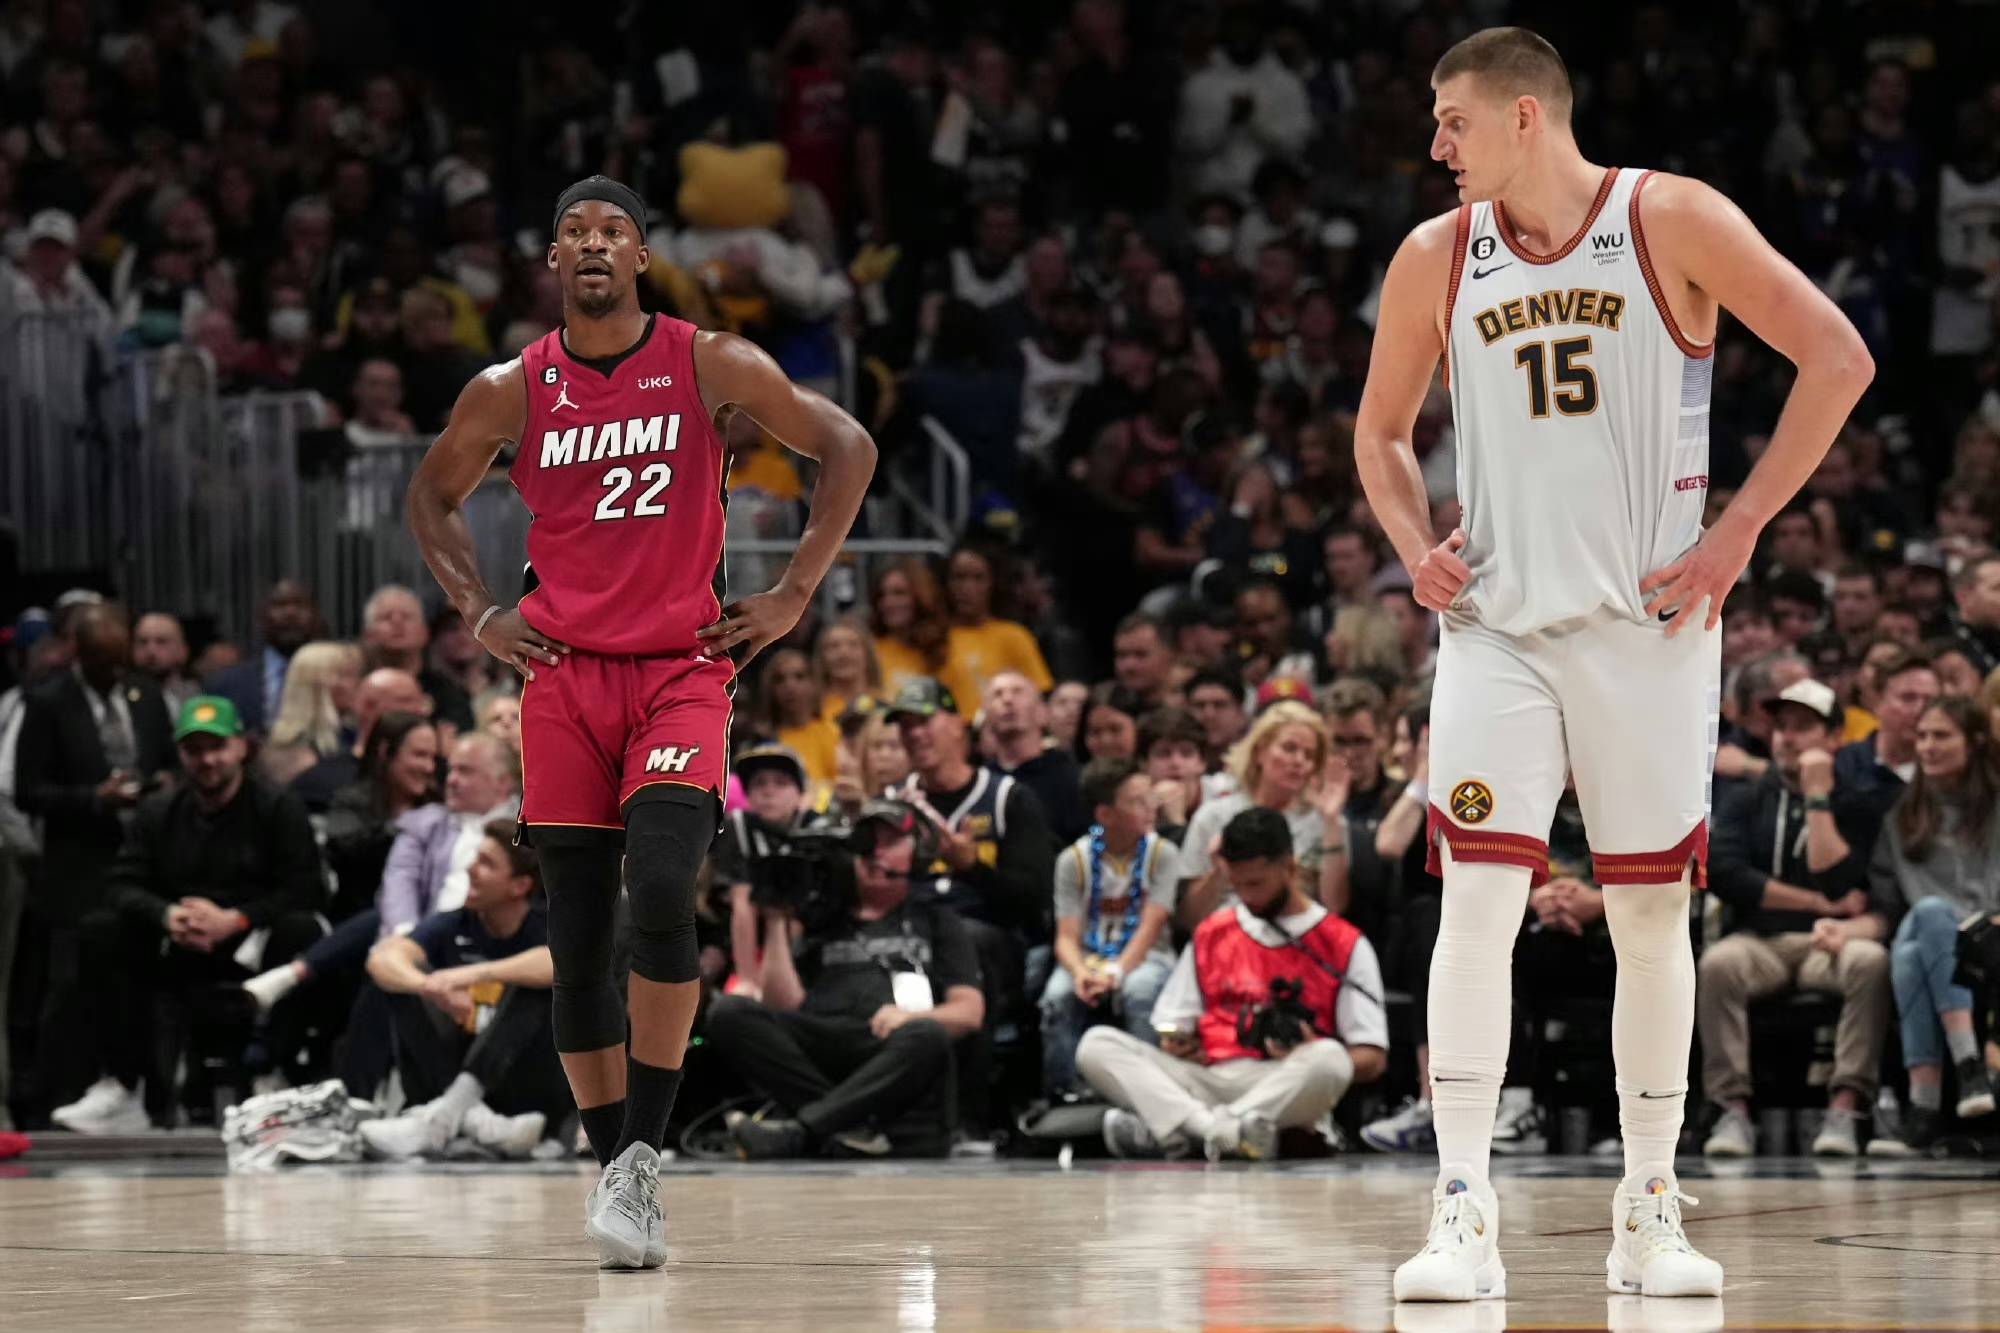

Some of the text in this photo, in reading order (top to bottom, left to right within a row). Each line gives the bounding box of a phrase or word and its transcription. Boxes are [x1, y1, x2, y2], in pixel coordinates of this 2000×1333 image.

[1478, 239, 1490, 258] 6
[1592, 233, 1623, 250] WU
[1592, 250, 1624, 260] Western
[1598, 257, 1620, 266] Union
[1473, 288, 1625, 346] DENVER
[545, 368, 557, 383] 6
[638, 376, 672, 389] UKG
[1515, 335, 1599, 419] 15
[540, 414, 681, 468] MIAMI
[595, 464, 671, 520] 22
